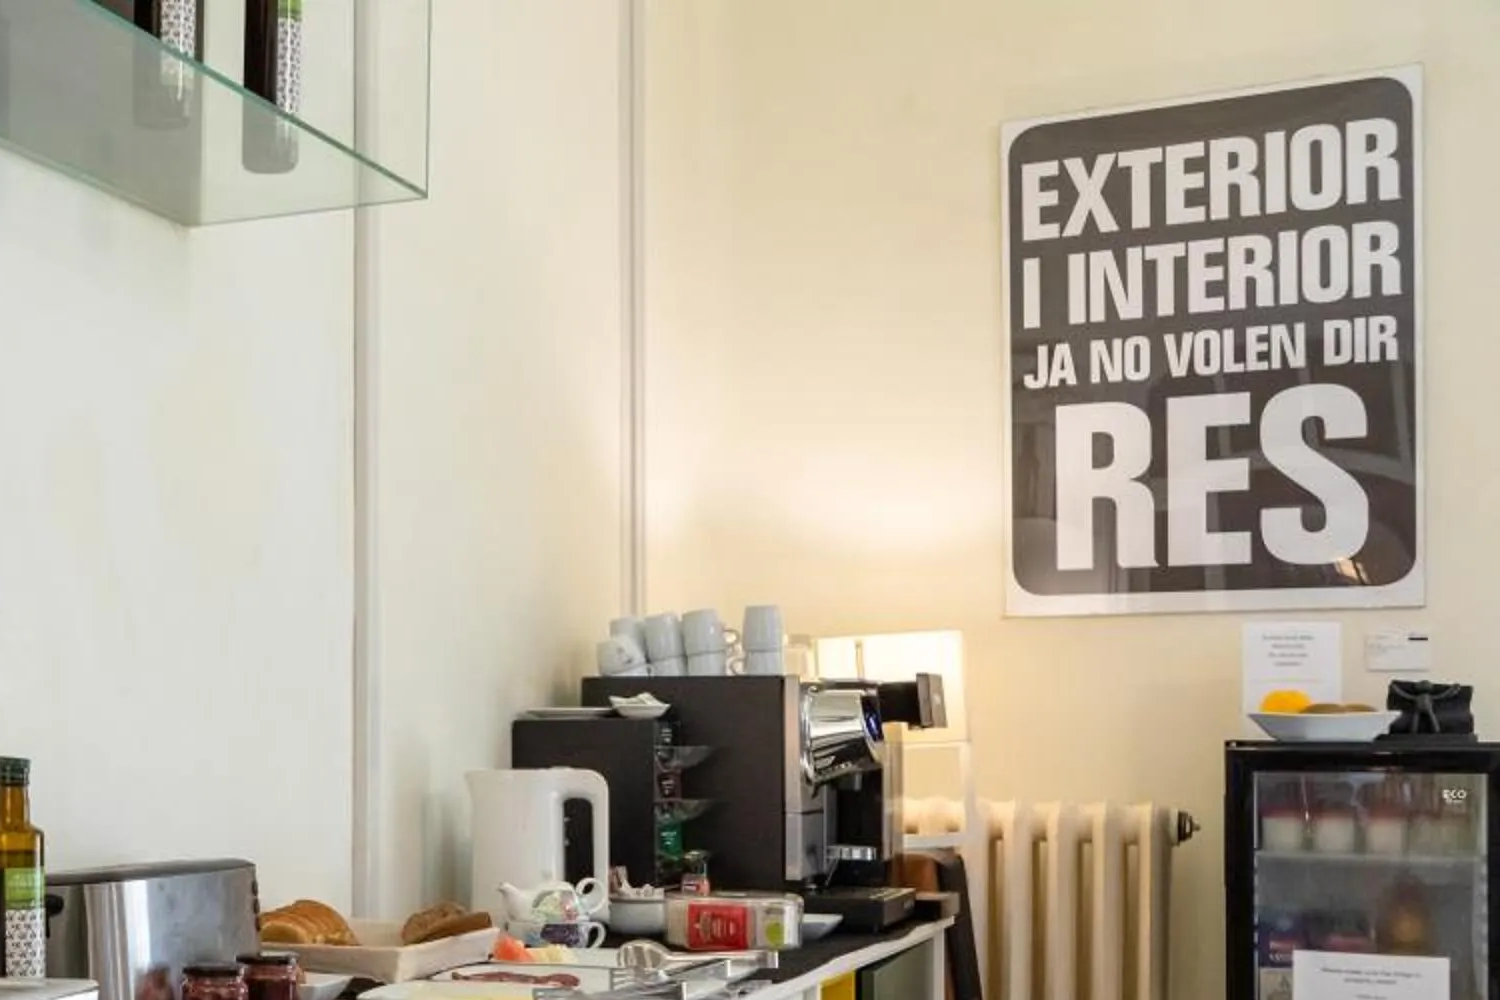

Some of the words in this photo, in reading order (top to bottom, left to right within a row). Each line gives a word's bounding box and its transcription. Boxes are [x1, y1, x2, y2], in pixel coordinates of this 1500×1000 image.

[1020, 117, 1402, 242] EXTERIOR
[1022, 256, 1042, 330] I
[1066, 220, 1403, 325] INTERIOR
[1023, 343, 1078, 390] JA
[1090, 335, 1151, 384] NO
[1164, 322, 1307, 379] VOLEN
[1322, 314, 1399, 367] DIR
[1054, 382, 1370, 572] RES
